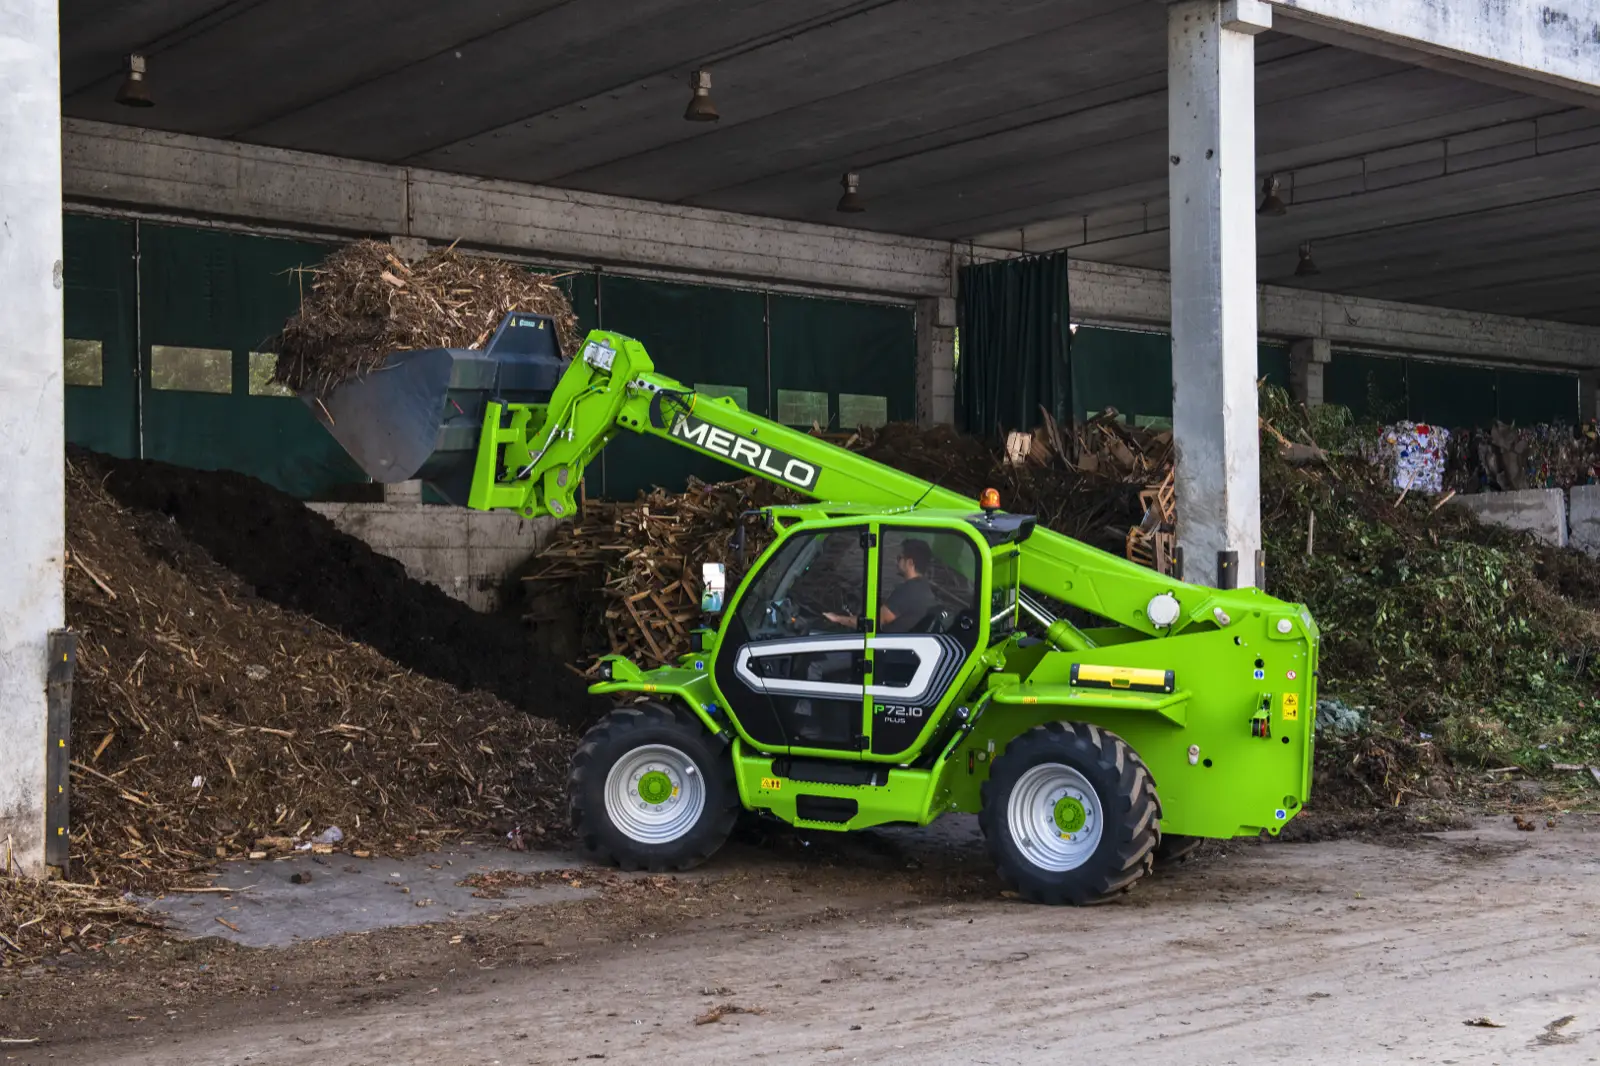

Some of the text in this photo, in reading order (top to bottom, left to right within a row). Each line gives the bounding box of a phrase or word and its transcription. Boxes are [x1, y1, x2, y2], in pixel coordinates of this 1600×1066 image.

[672, 414, 815, 487] MERLO
[874, 704, 923, 717] P72.10
[884, 716, 906, 724] PLUS
